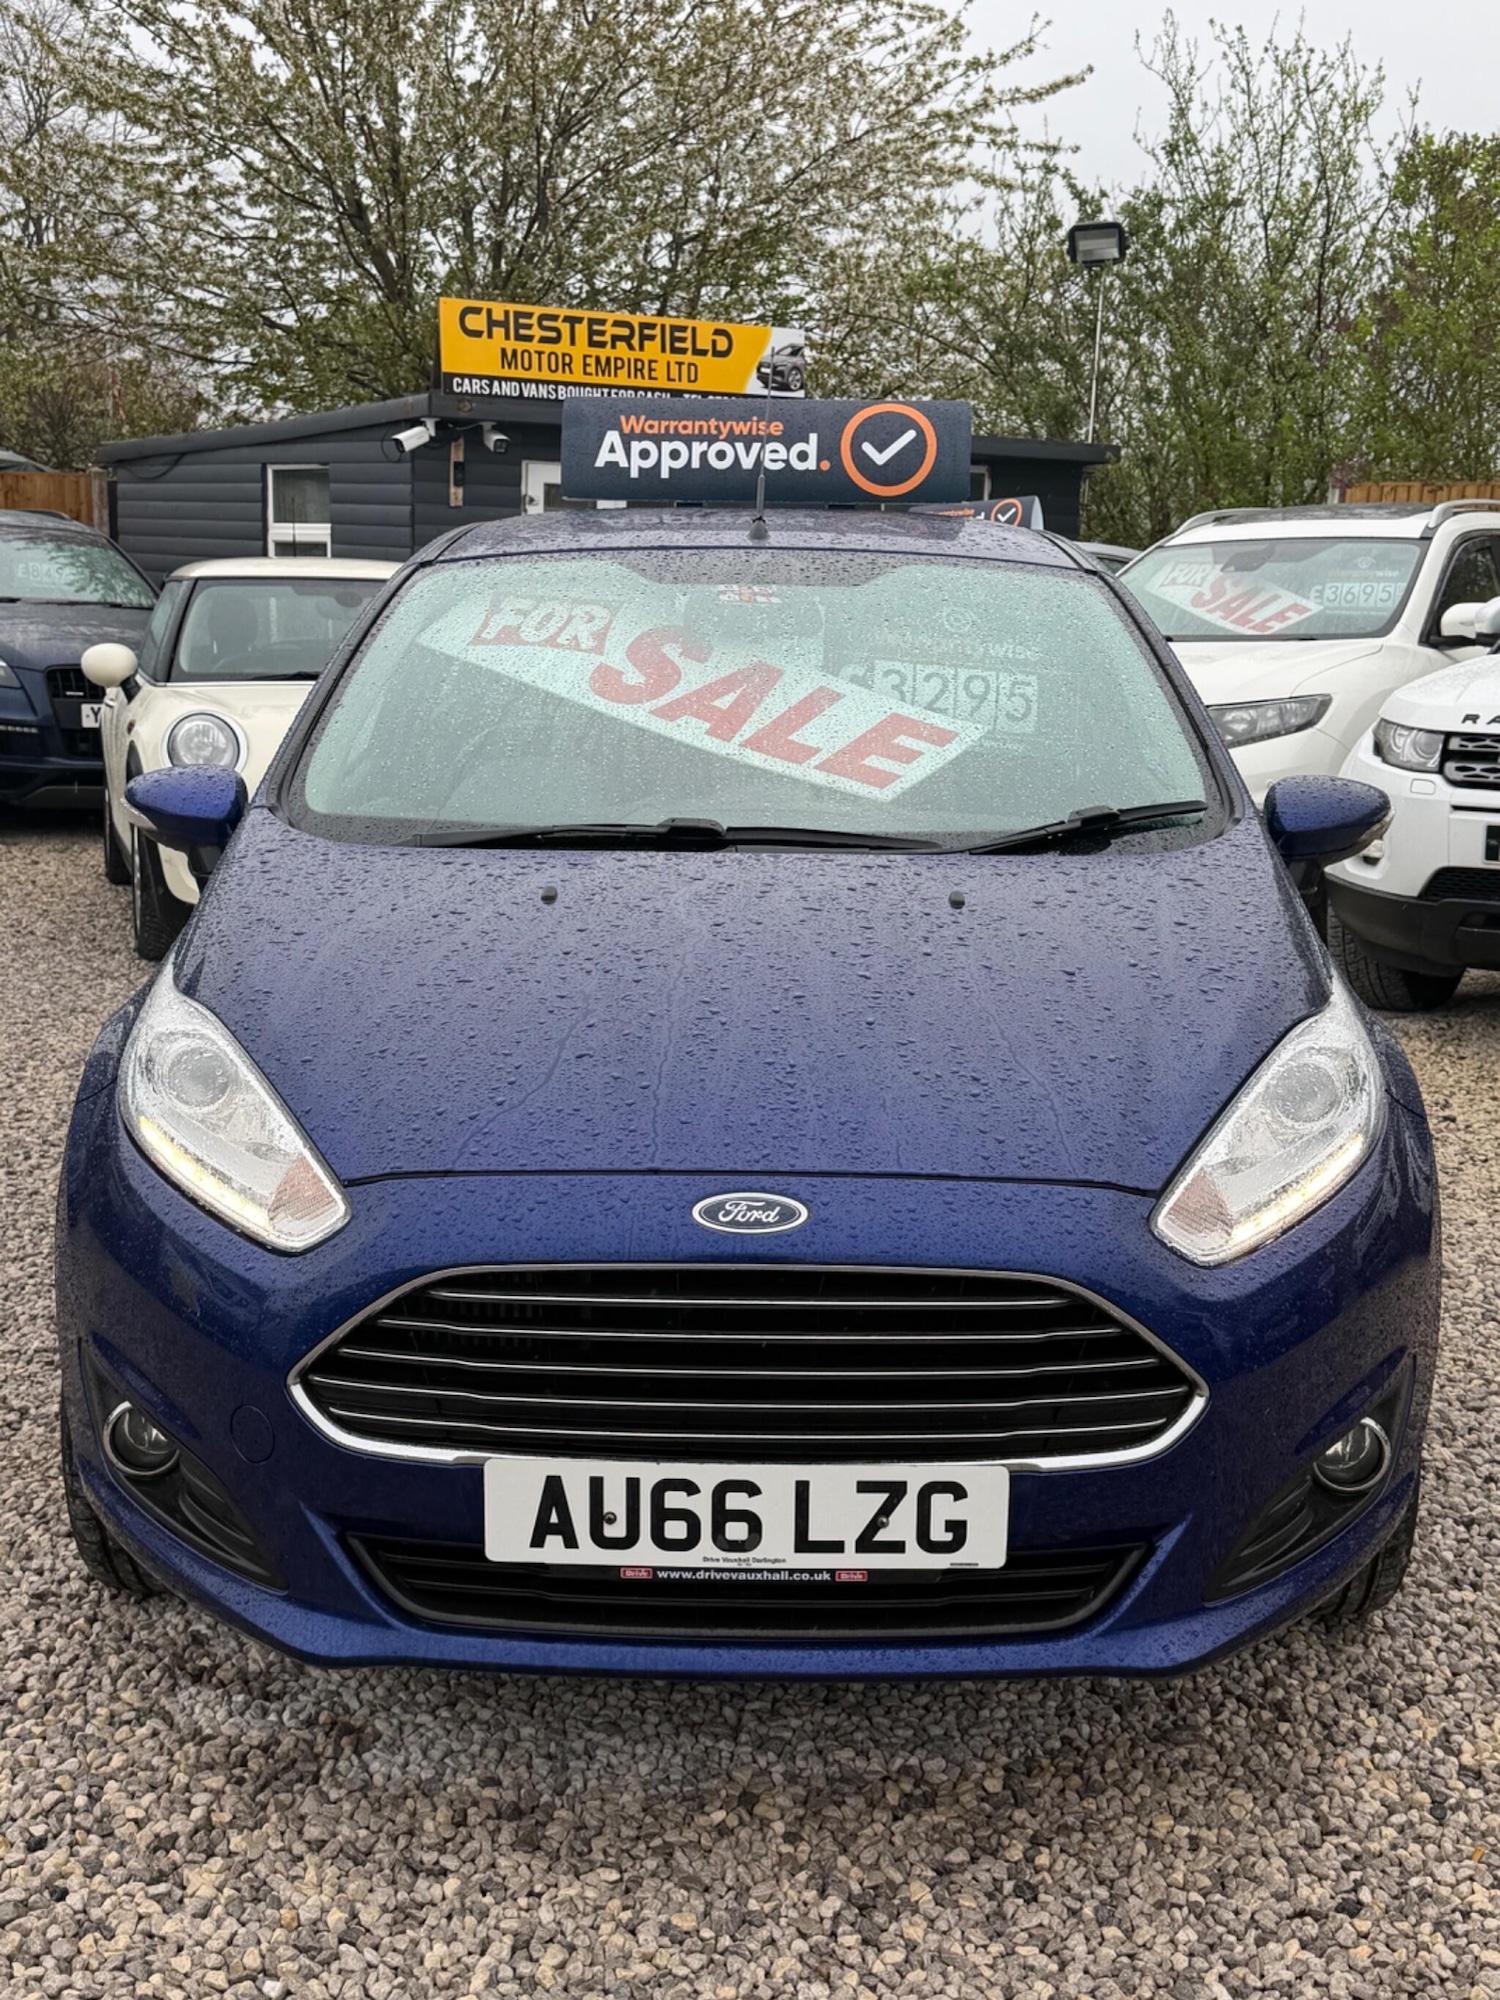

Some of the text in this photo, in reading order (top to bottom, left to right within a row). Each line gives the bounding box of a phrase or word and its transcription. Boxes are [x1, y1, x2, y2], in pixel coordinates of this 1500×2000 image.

[458, 306, 734, 359] CHESTERFIELD
[500, 347, 699, 384] MOTOR EMPIRE LTD
[453, 377, 490, 395] CARS
[491, 381, 520, 397] AND
[521, 383, 556, 400] VANS
[619, 415, 784, 440] Warrantywise
[594, 430, 831, 479] Approved.
[1163, 562, 1208, 587] FOR
[1191, 574, 1313, 633] SALE
[1310, 584, 1393, 605] £3695
[480, 602, 612, 650] FOR
[589, 624, 959, 790] SALE
[718, 1200, 780, 1222] Ford
[529, 1475, 969, 1554] AU66 LZG
[656, 1569, 832, 1582] www.drivevauxhall.co.uk
